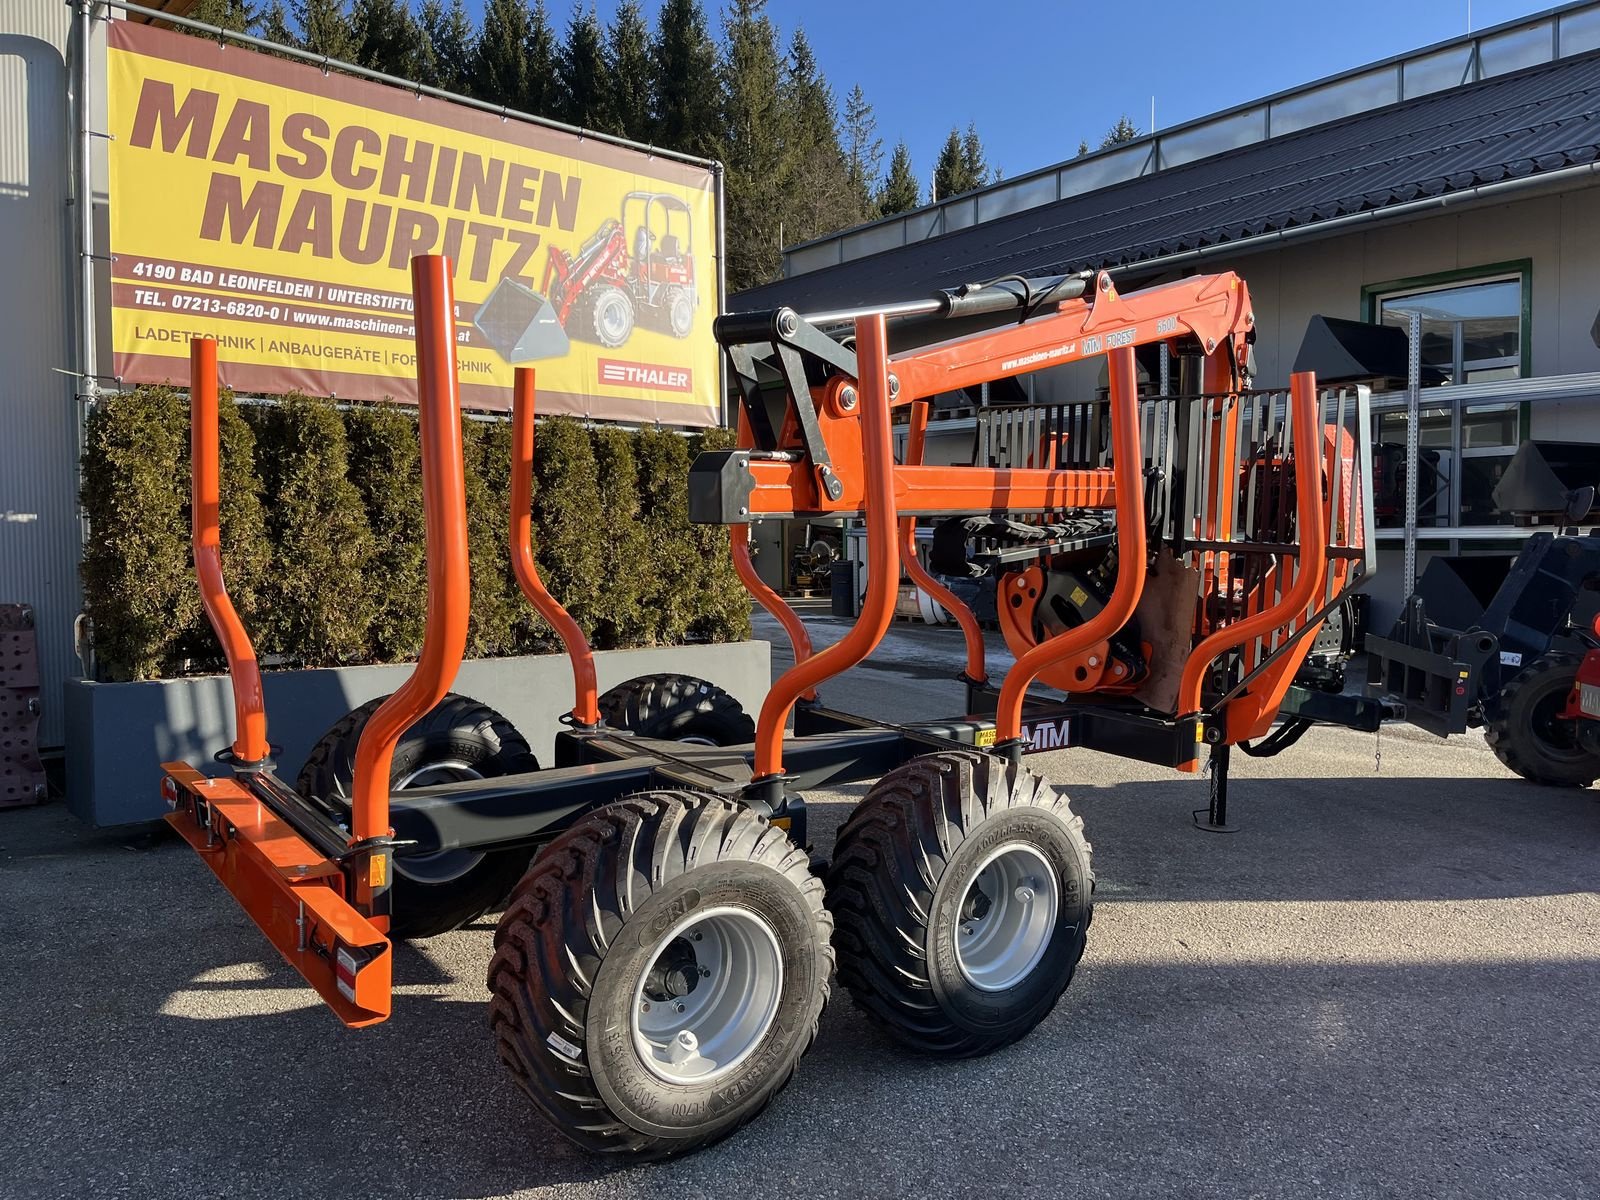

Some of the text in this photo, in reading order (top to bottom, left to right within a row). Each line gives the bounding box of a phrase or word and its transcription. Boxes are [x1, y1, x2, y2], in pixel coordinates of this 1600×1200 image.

[129, 77, 582, 232] MASCHINEN
[199, 171, 541, 290] MAURITZ
[132, 262, 176, 280] 4190
[180, 268, 214, 285] BAD
[218, 273, 314, 299] LEONFELDEN
[327, 288, 415, 311] UNTERSTIFTU
[134, 290, 167, 307] TEL.
[172, 294, 280, 320] 07213-6820-0
[268, 340, 381, 363] ANBAUGERÄTE
[1105, 327, 1137, 348] FOREST
[626, 367, 688, 387] THALER
[1021, 719, 1070, 751] MTM
